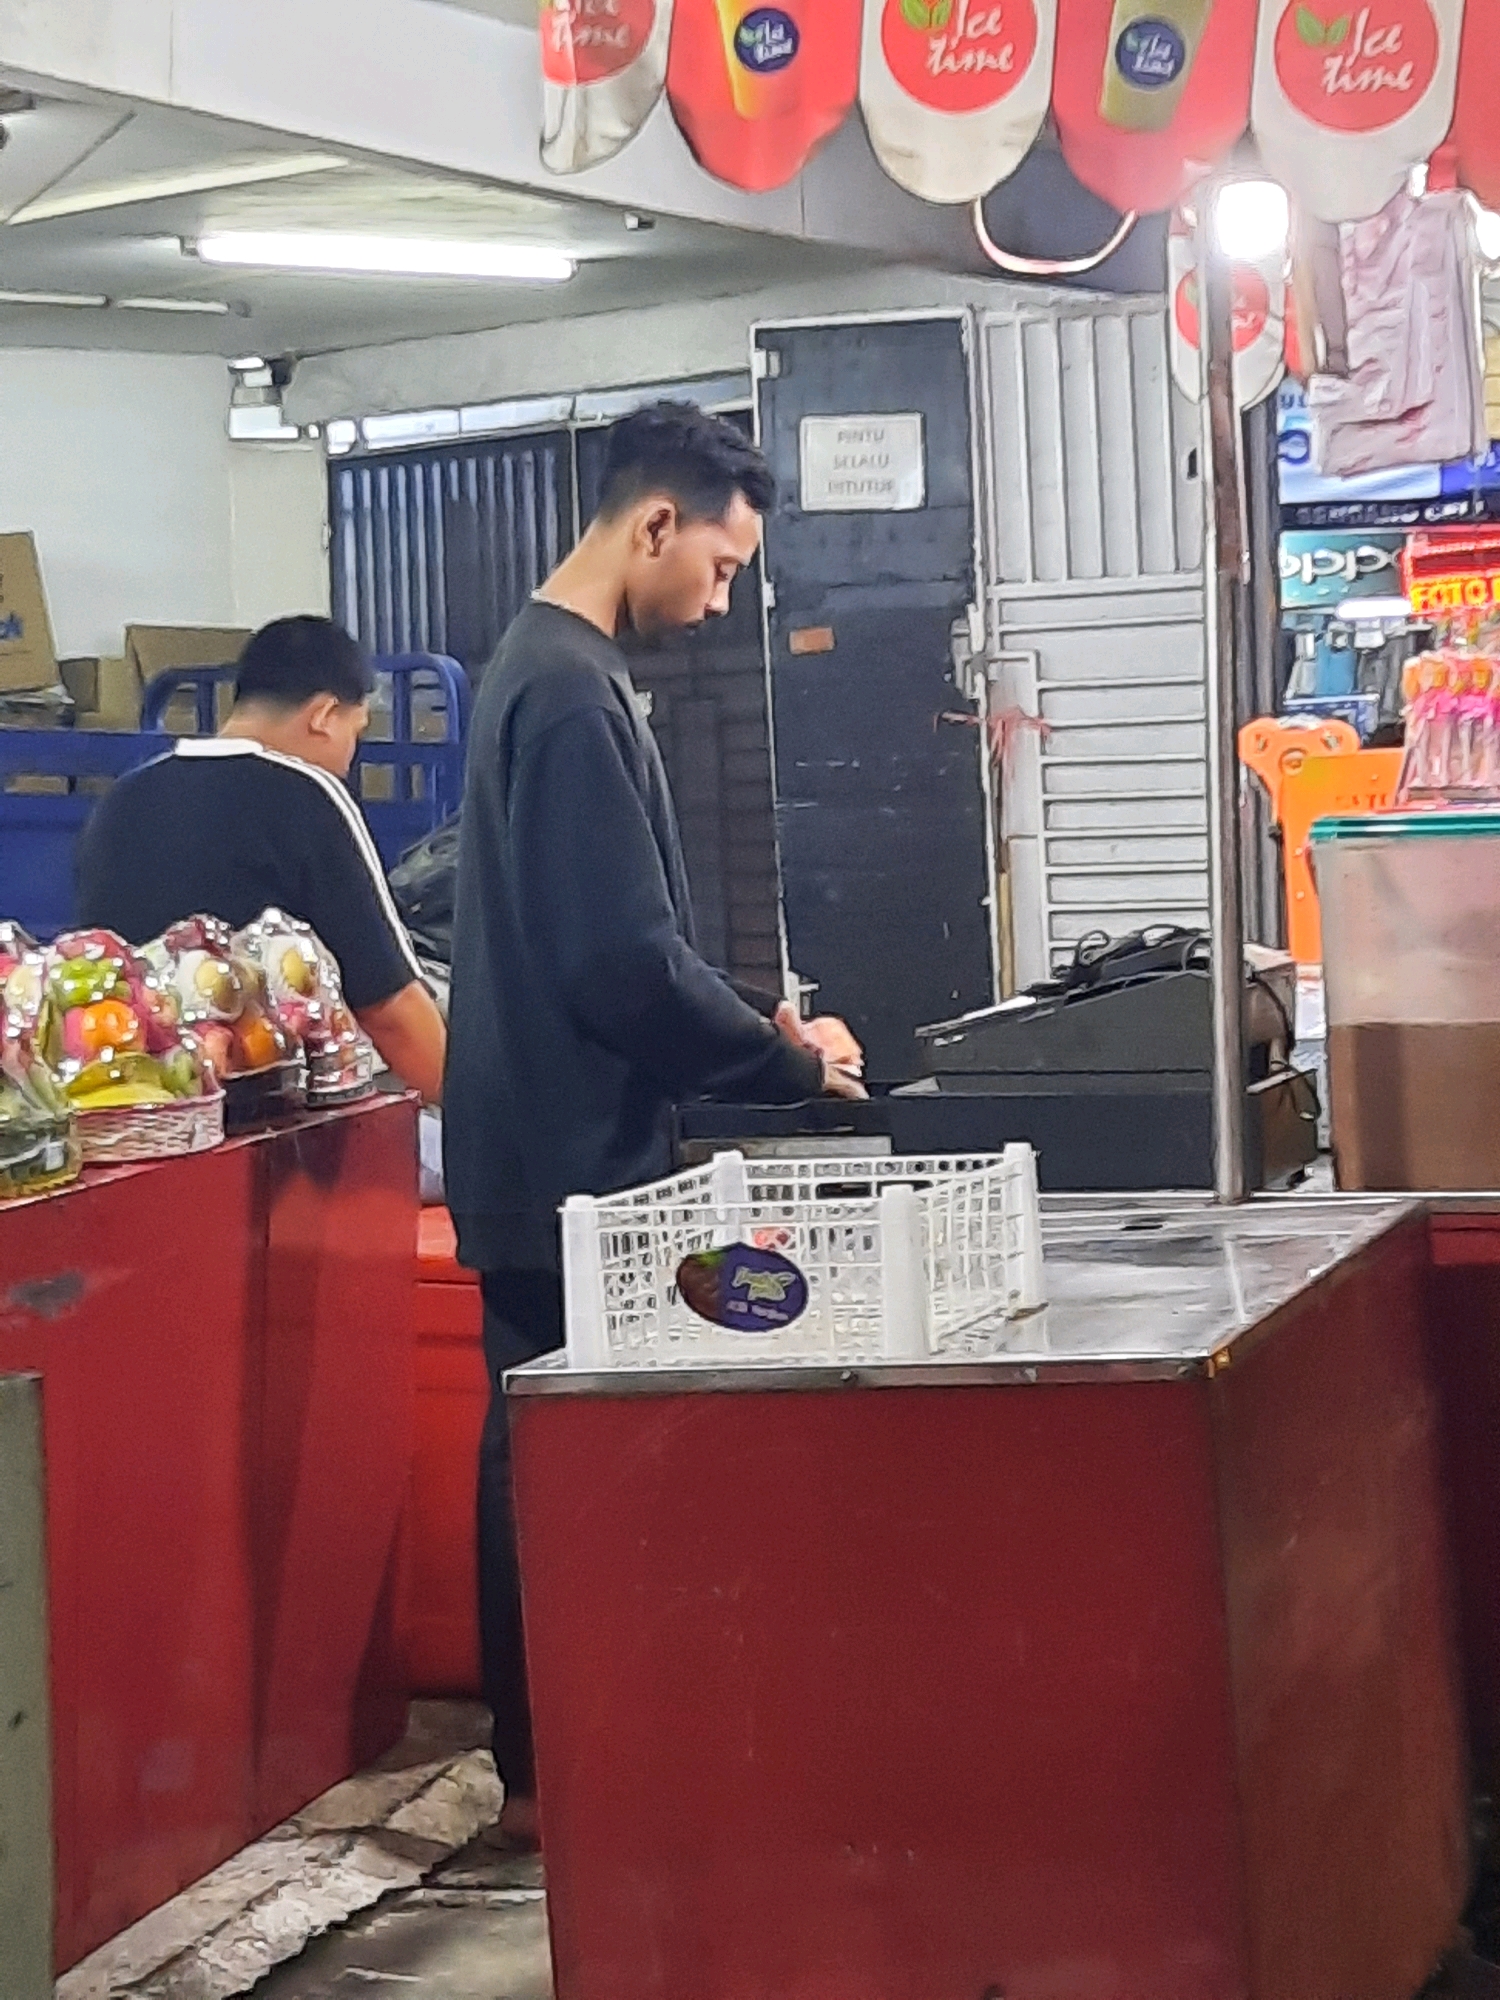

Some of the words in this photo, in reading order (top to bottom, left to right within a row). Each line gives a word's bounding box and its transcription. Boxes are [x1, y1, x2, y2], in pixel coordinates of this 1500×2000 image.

[927, 34, 1013, 76] time
[1345, 7, 1402, 68] Ice
[1321, 55, 1414, 95] time
